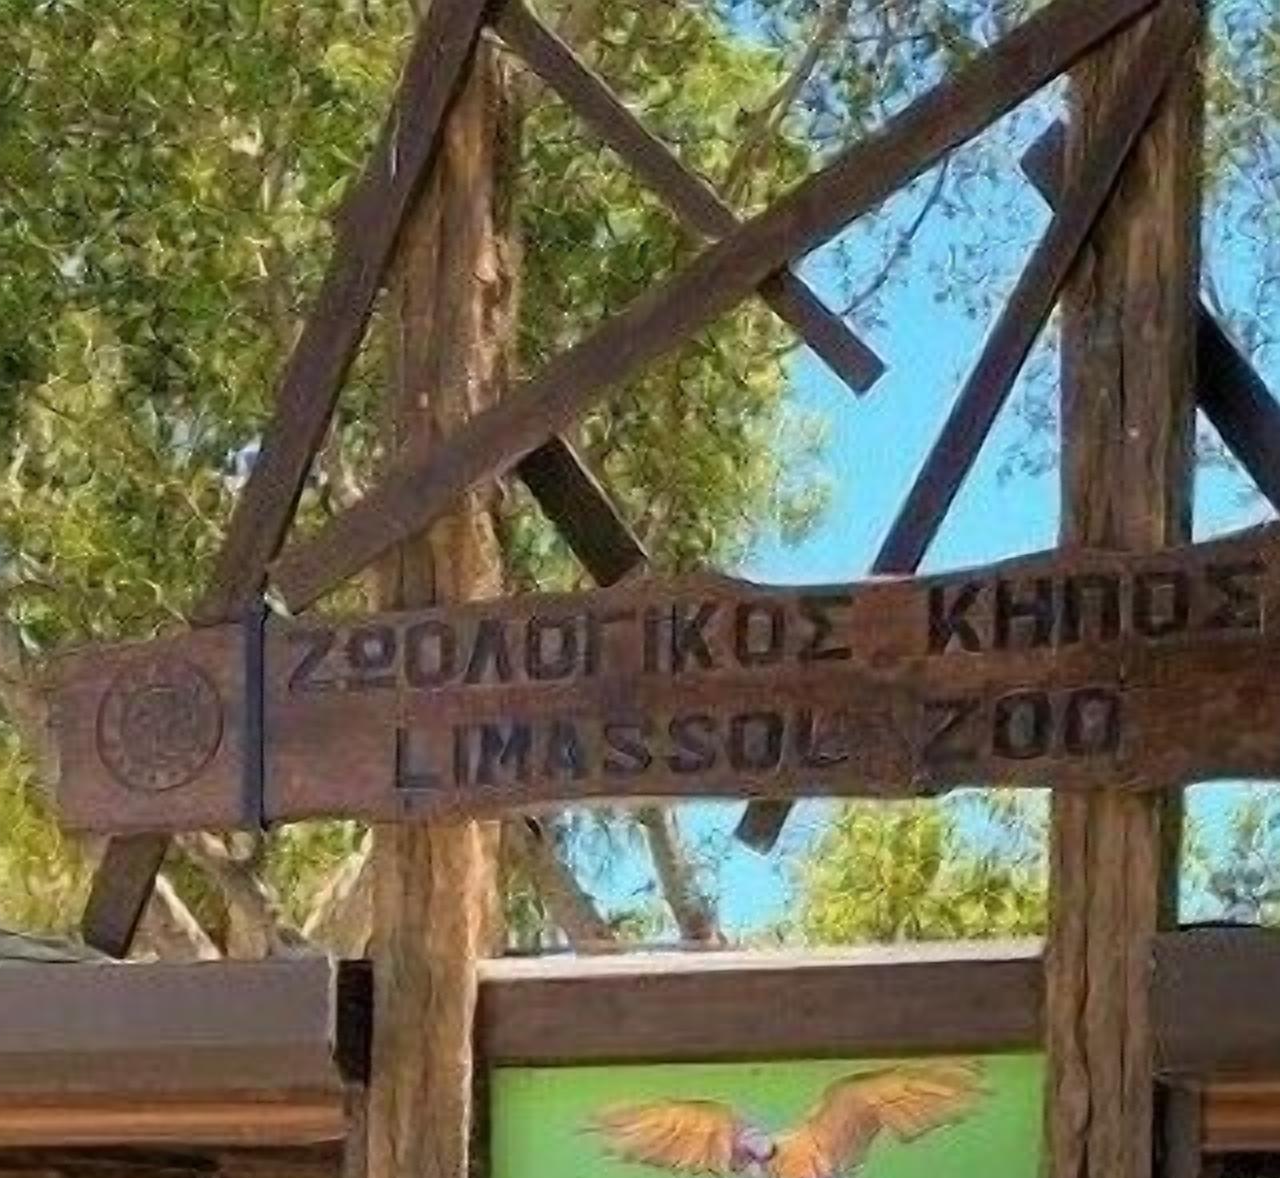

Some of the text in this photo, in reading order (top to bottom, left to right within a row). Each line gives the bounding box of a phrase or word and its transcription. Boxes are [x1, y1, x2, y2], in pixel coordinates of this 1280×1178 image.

[287, 562, 1272, 692] ΖΩΟΛΟΓΙΚΟΣ ΚΗΠΟΣ
[394, 687, 1123, 790] LIMASSOL ZOO
